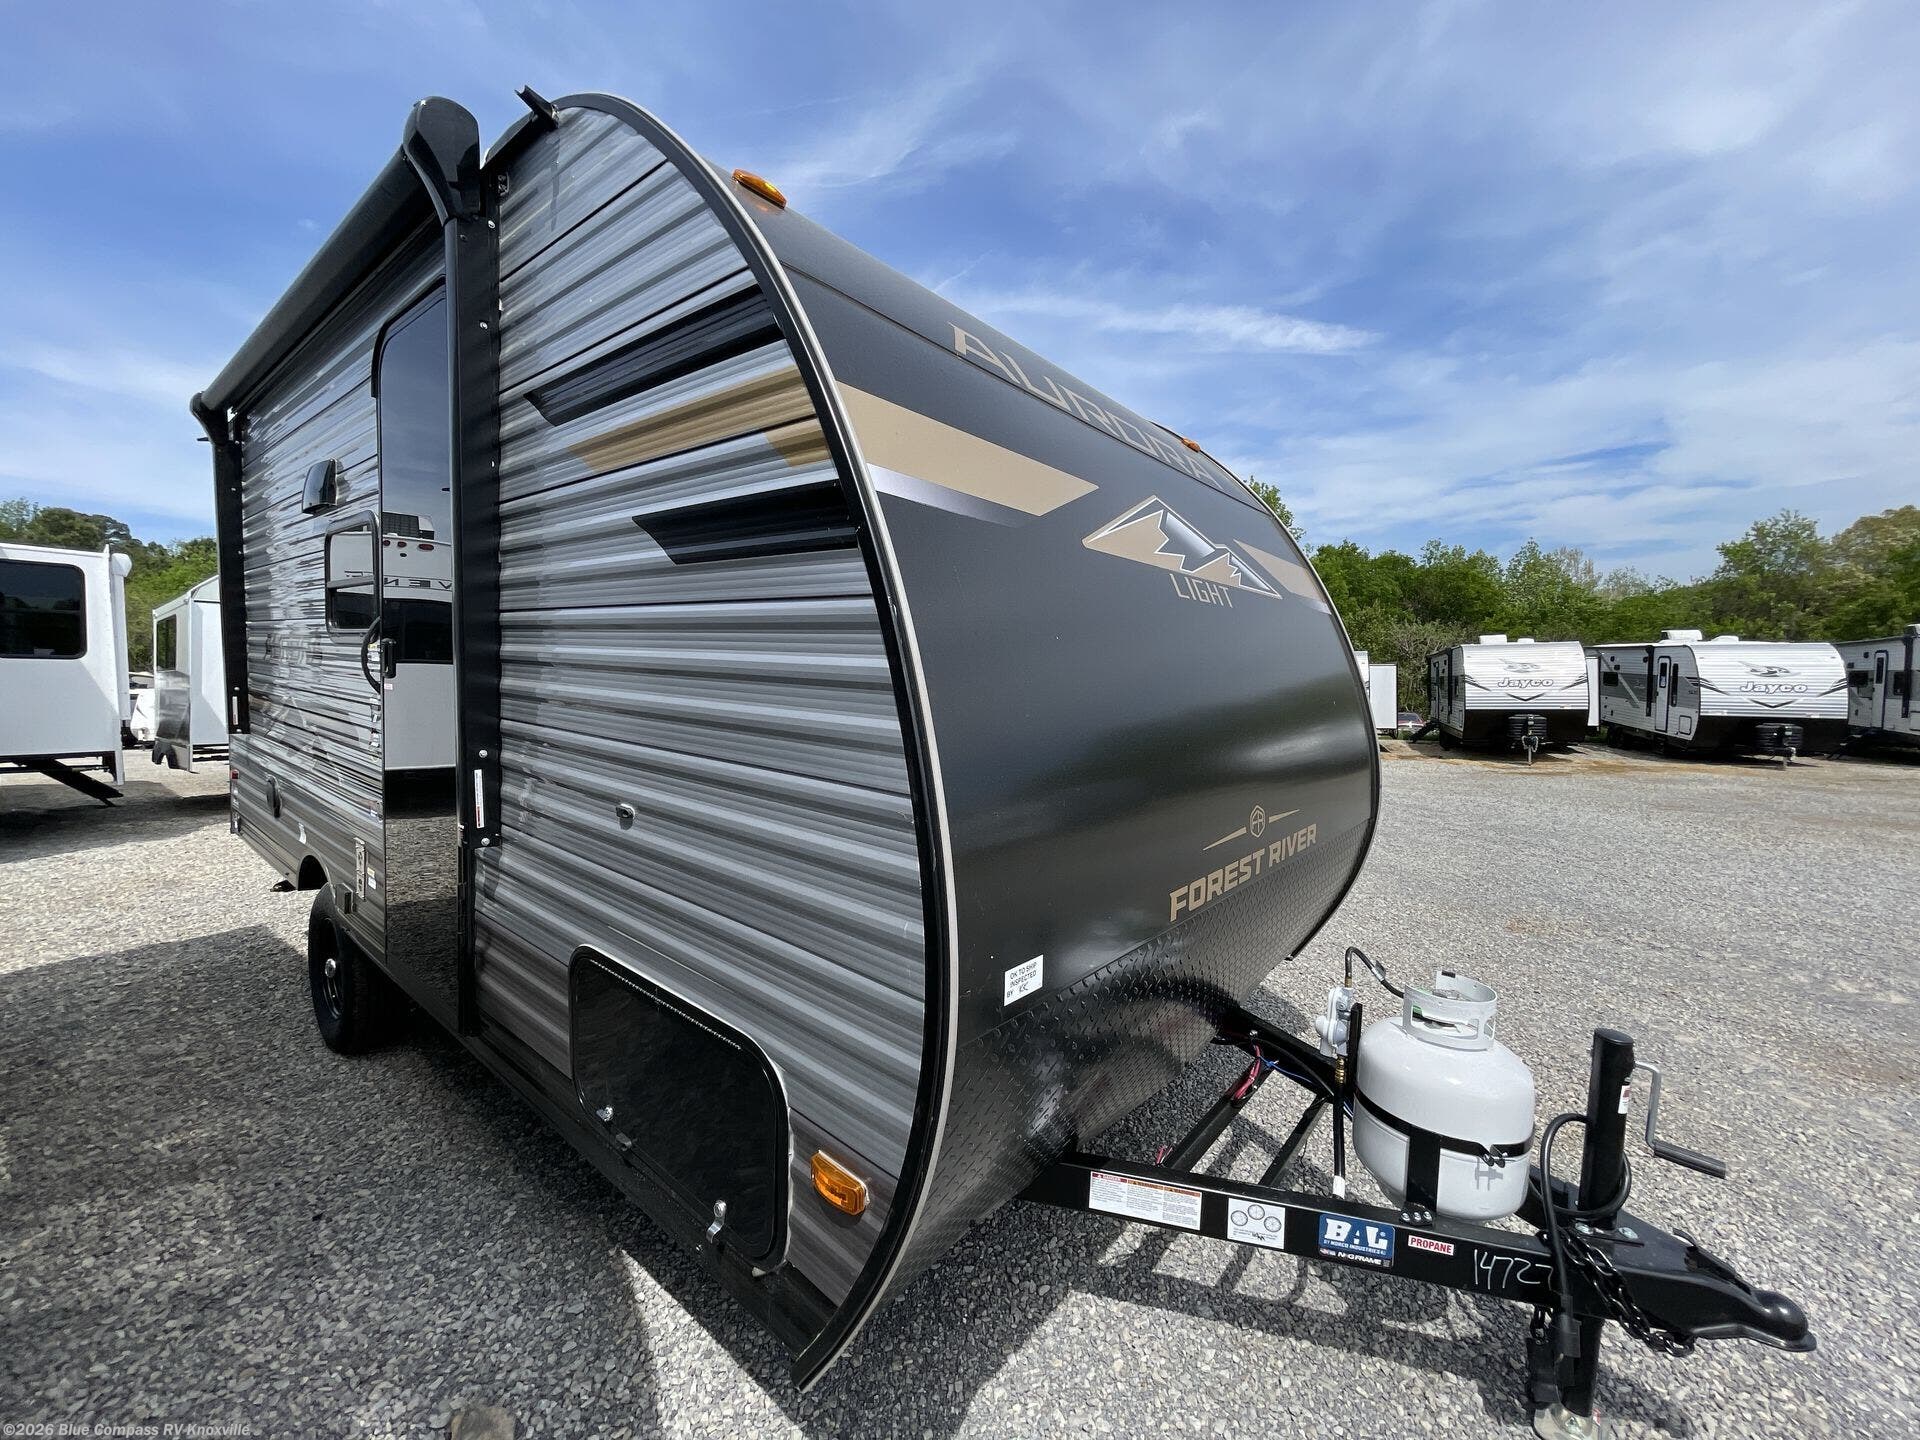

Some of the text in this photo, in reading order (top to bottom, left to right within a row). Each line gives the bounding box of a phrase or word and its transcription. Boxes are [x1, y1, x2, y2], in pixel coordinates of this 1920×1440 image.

[947, 321, 1225, 491] AURORA
[1169, 573, 1233, 608] LIGHT
[1497, 676, 1554, 689] Jayco
[1739, 680, 1808, 694] Jayco
[1169, 823, 1317, 922] FOREST RIVER
[1324, 1218, 1388, 1250] BAL
[1410, 1237, 1452, 1254] PROPANE
